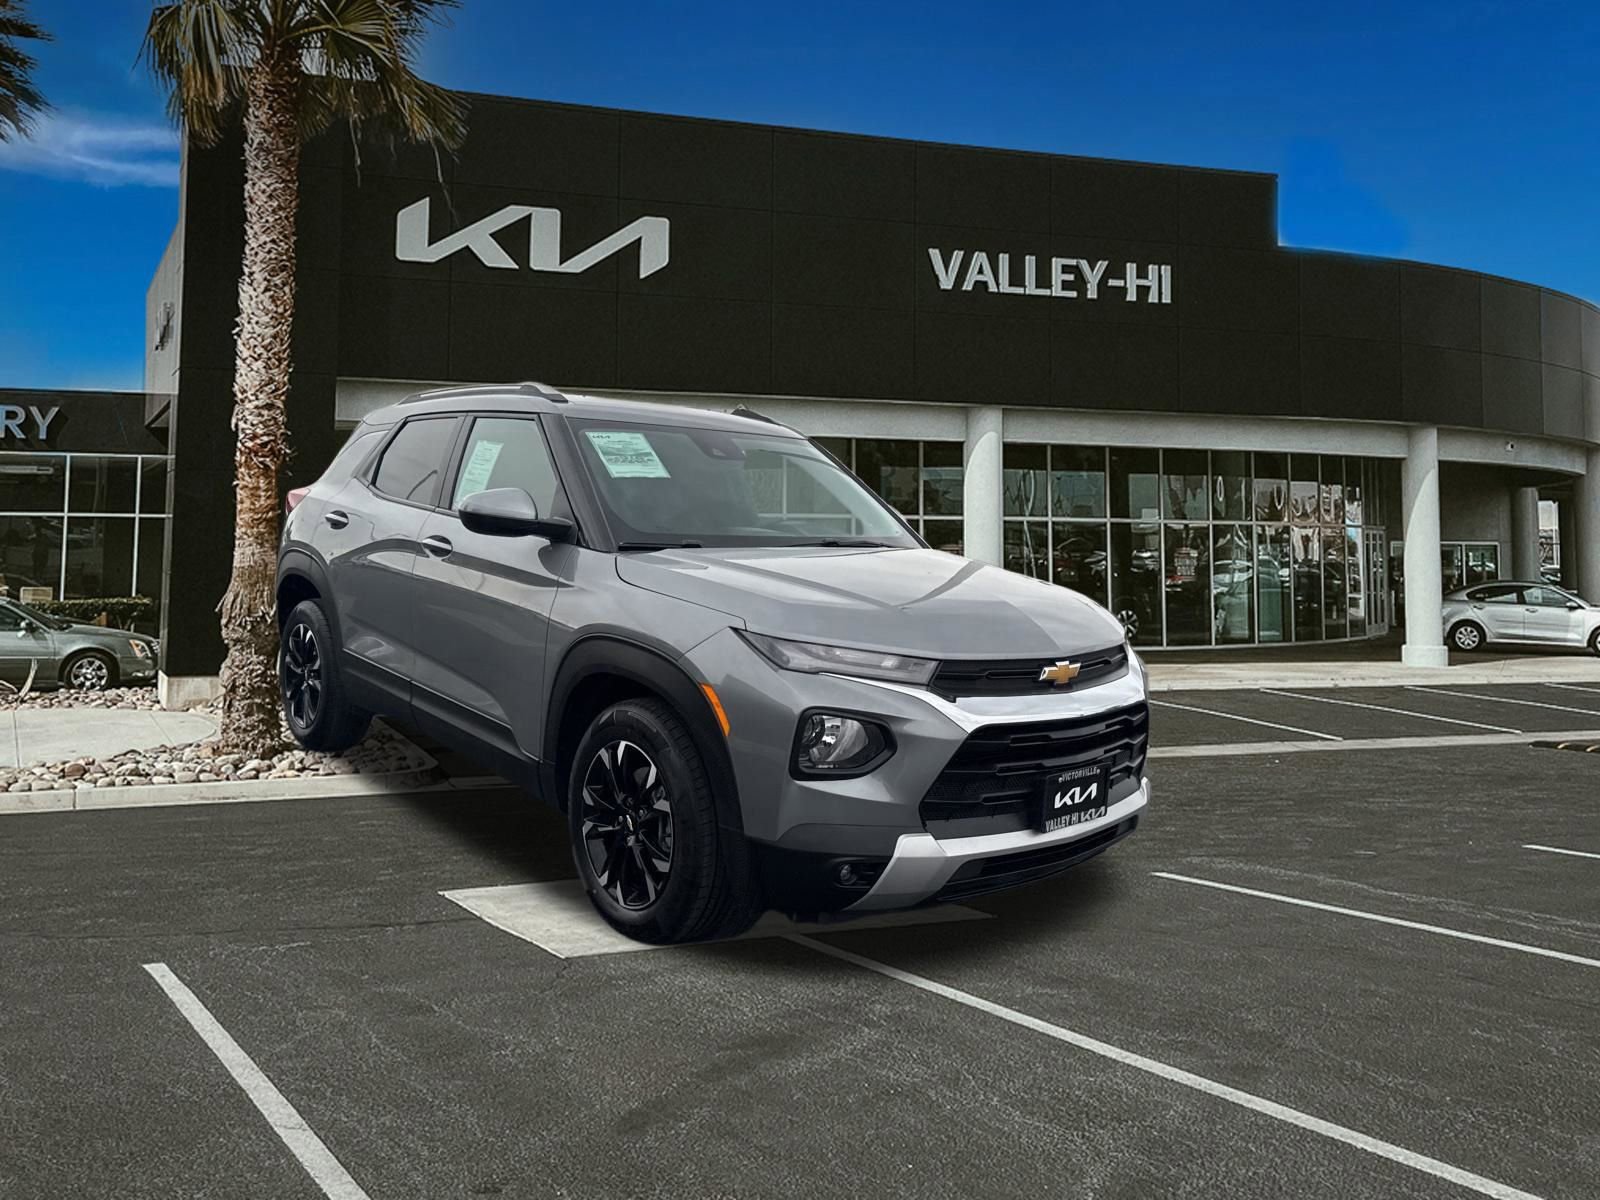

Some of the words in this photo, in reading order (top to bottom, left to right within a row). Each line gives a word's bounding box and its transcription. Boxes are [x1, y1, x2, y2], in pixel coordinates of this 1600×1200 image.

[396, 196, 670, 280] KIA
[928, 248, 1172, 303] VALLEY-HI
[0, 405, 60, 440] RY
[1054, 782, 1098, 809] KIA
[1045, 814, 1071, 832] VALLEY
[1071, 812, 1079, 825] HI
